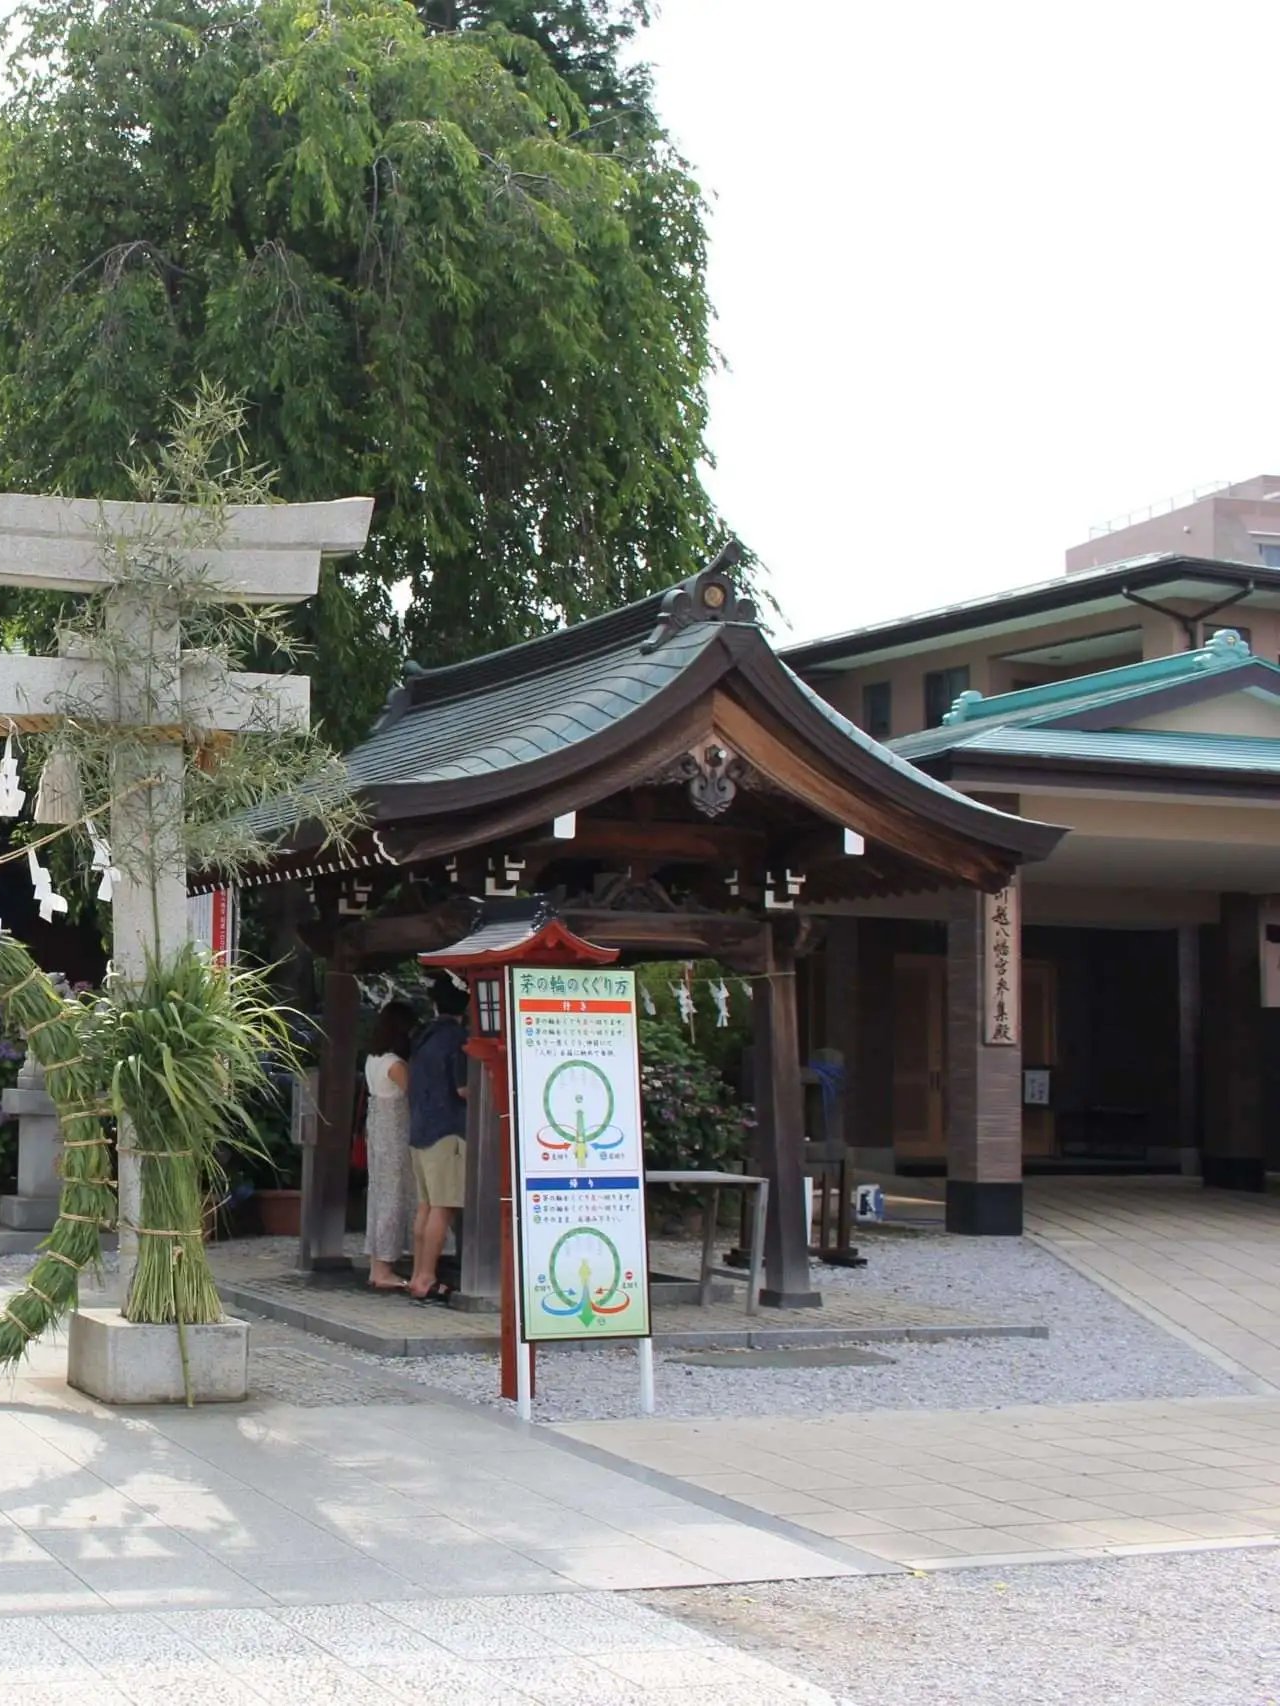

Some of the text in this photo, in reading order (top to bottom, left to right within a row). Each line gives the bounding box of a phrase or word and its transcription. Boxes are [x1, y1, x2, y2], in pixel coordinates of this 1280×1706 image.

[520, 973, 629, 996] 茅の輪のくぐり方
